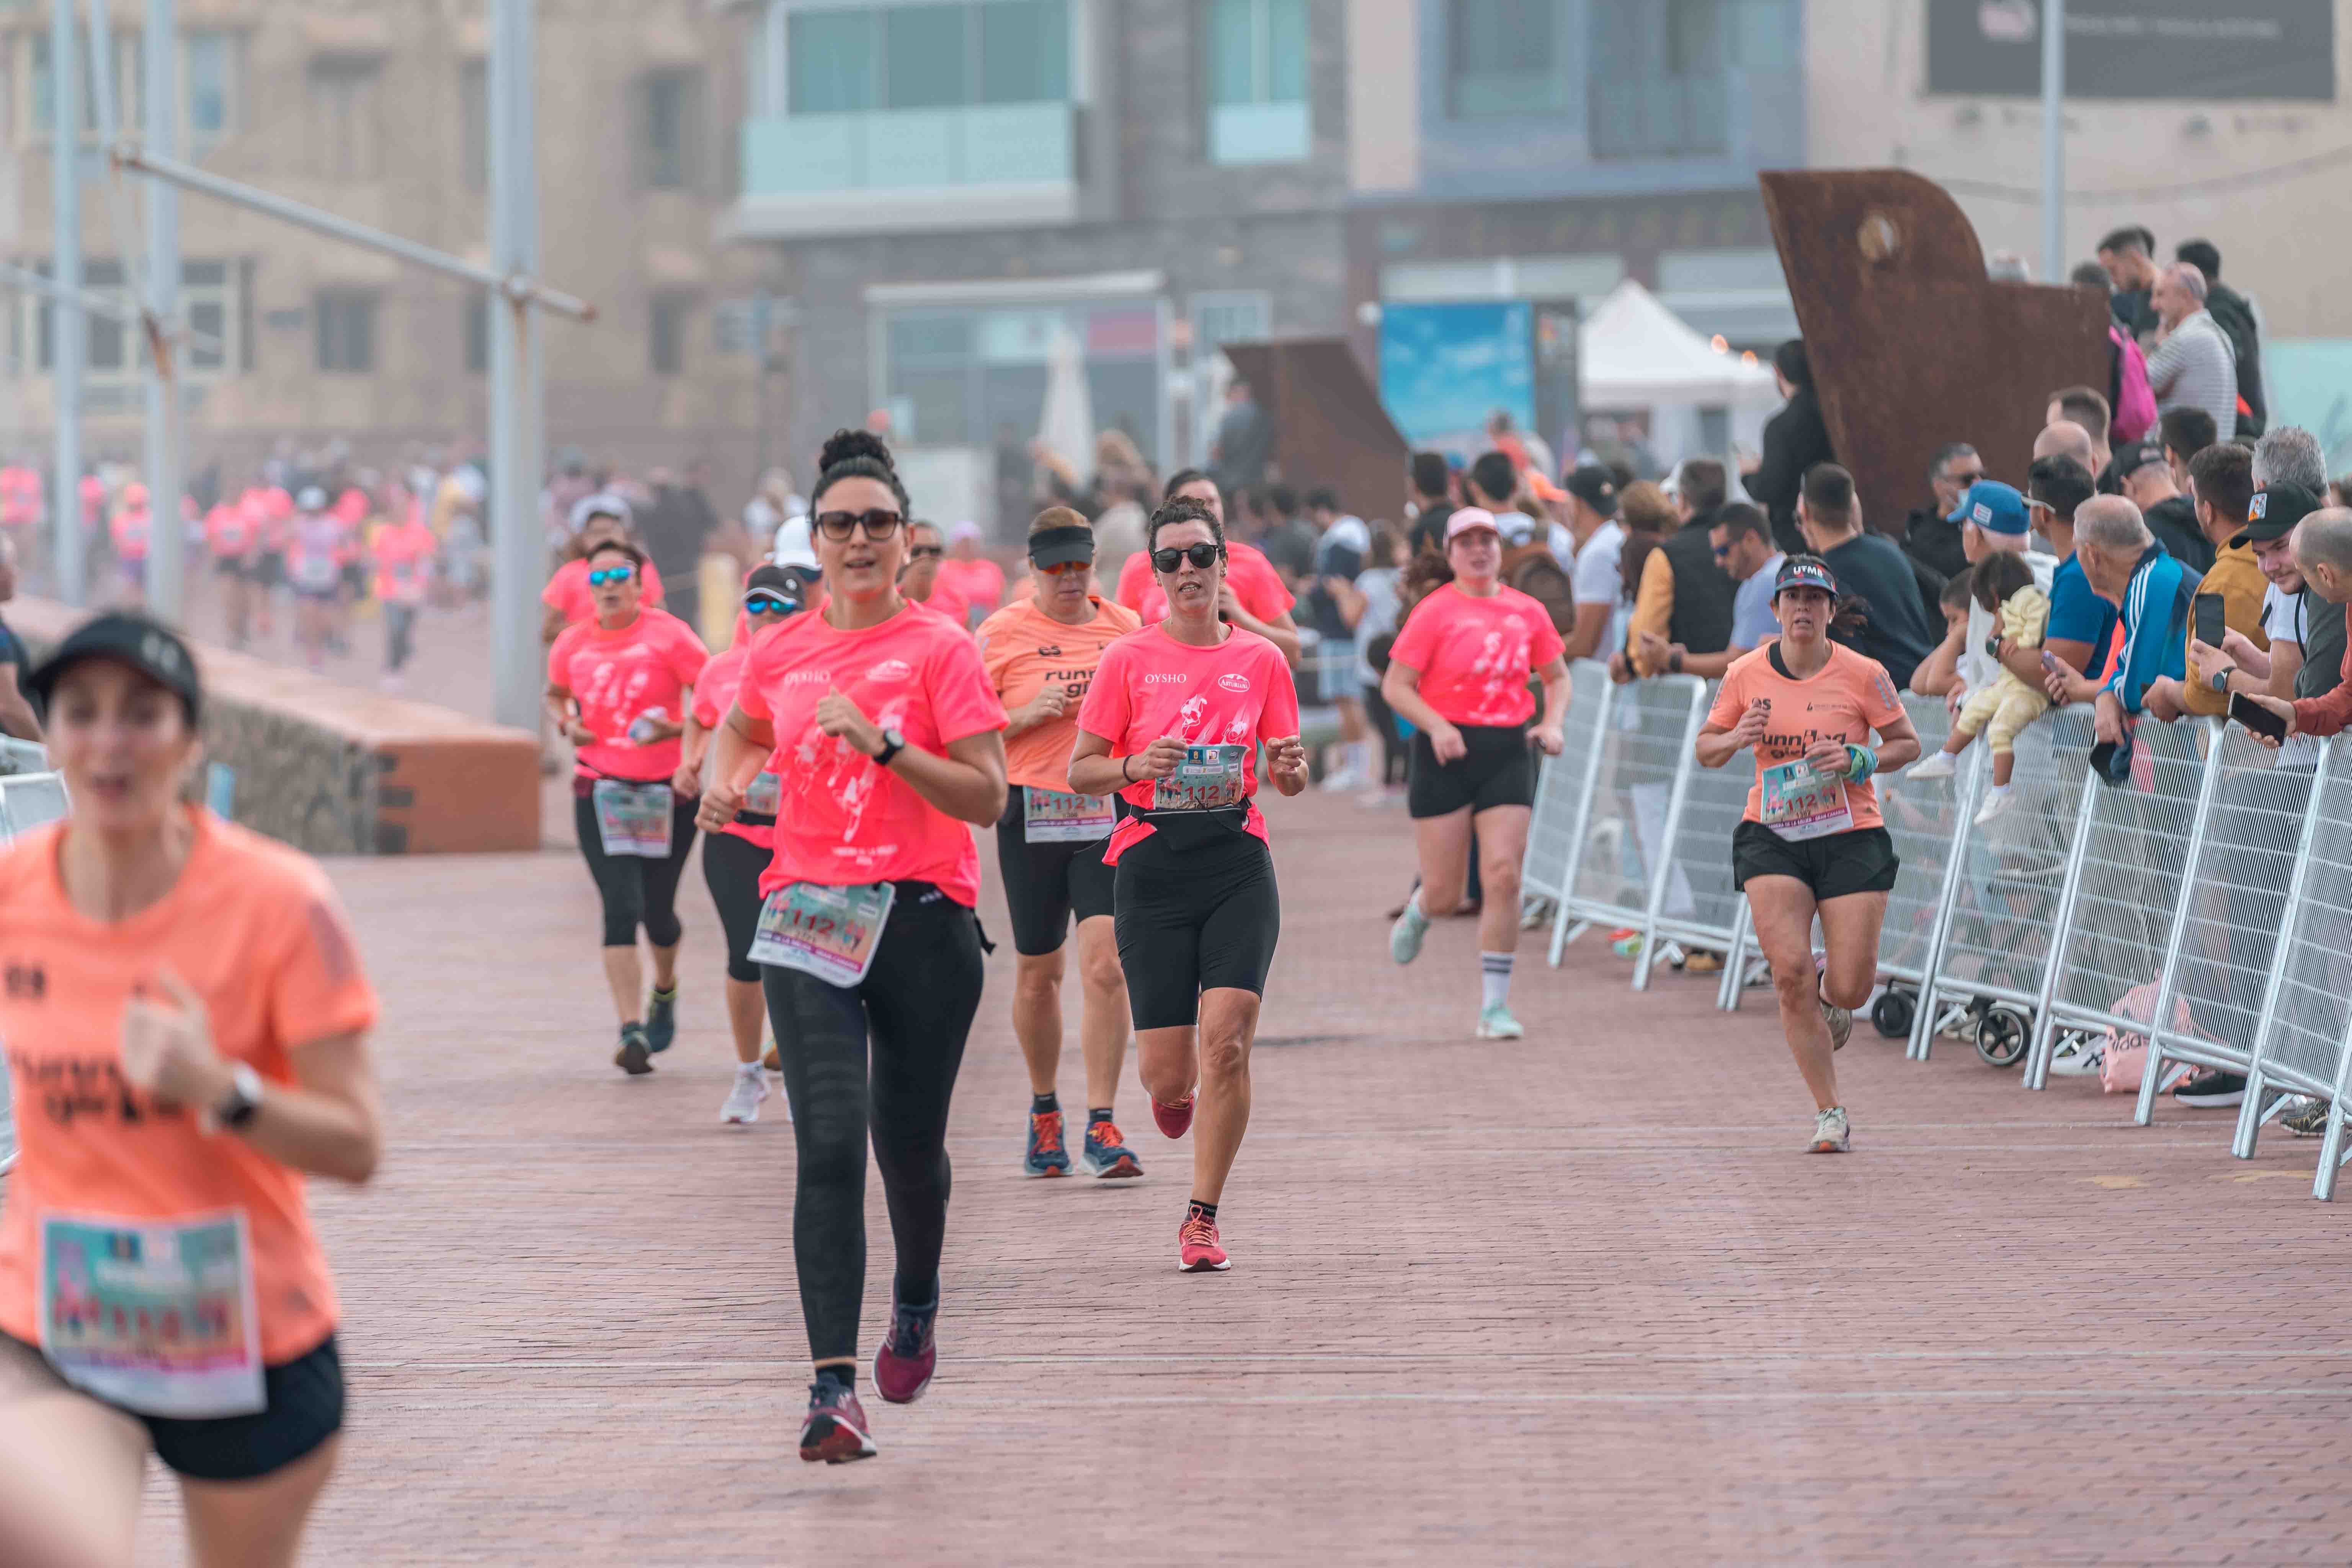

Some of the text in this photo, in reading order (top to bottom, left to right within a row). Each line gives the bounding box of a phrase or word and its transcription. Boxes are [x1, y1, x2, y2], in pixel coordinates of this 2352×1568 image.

[1145, 674, 1186, 683] OYSHO
[1185, 786, 1220, 801] 112
[1053, 795, 1085, 810] 112
[1785, 794, 1817, 814] 112
[792, 908, 835, 935] 112
